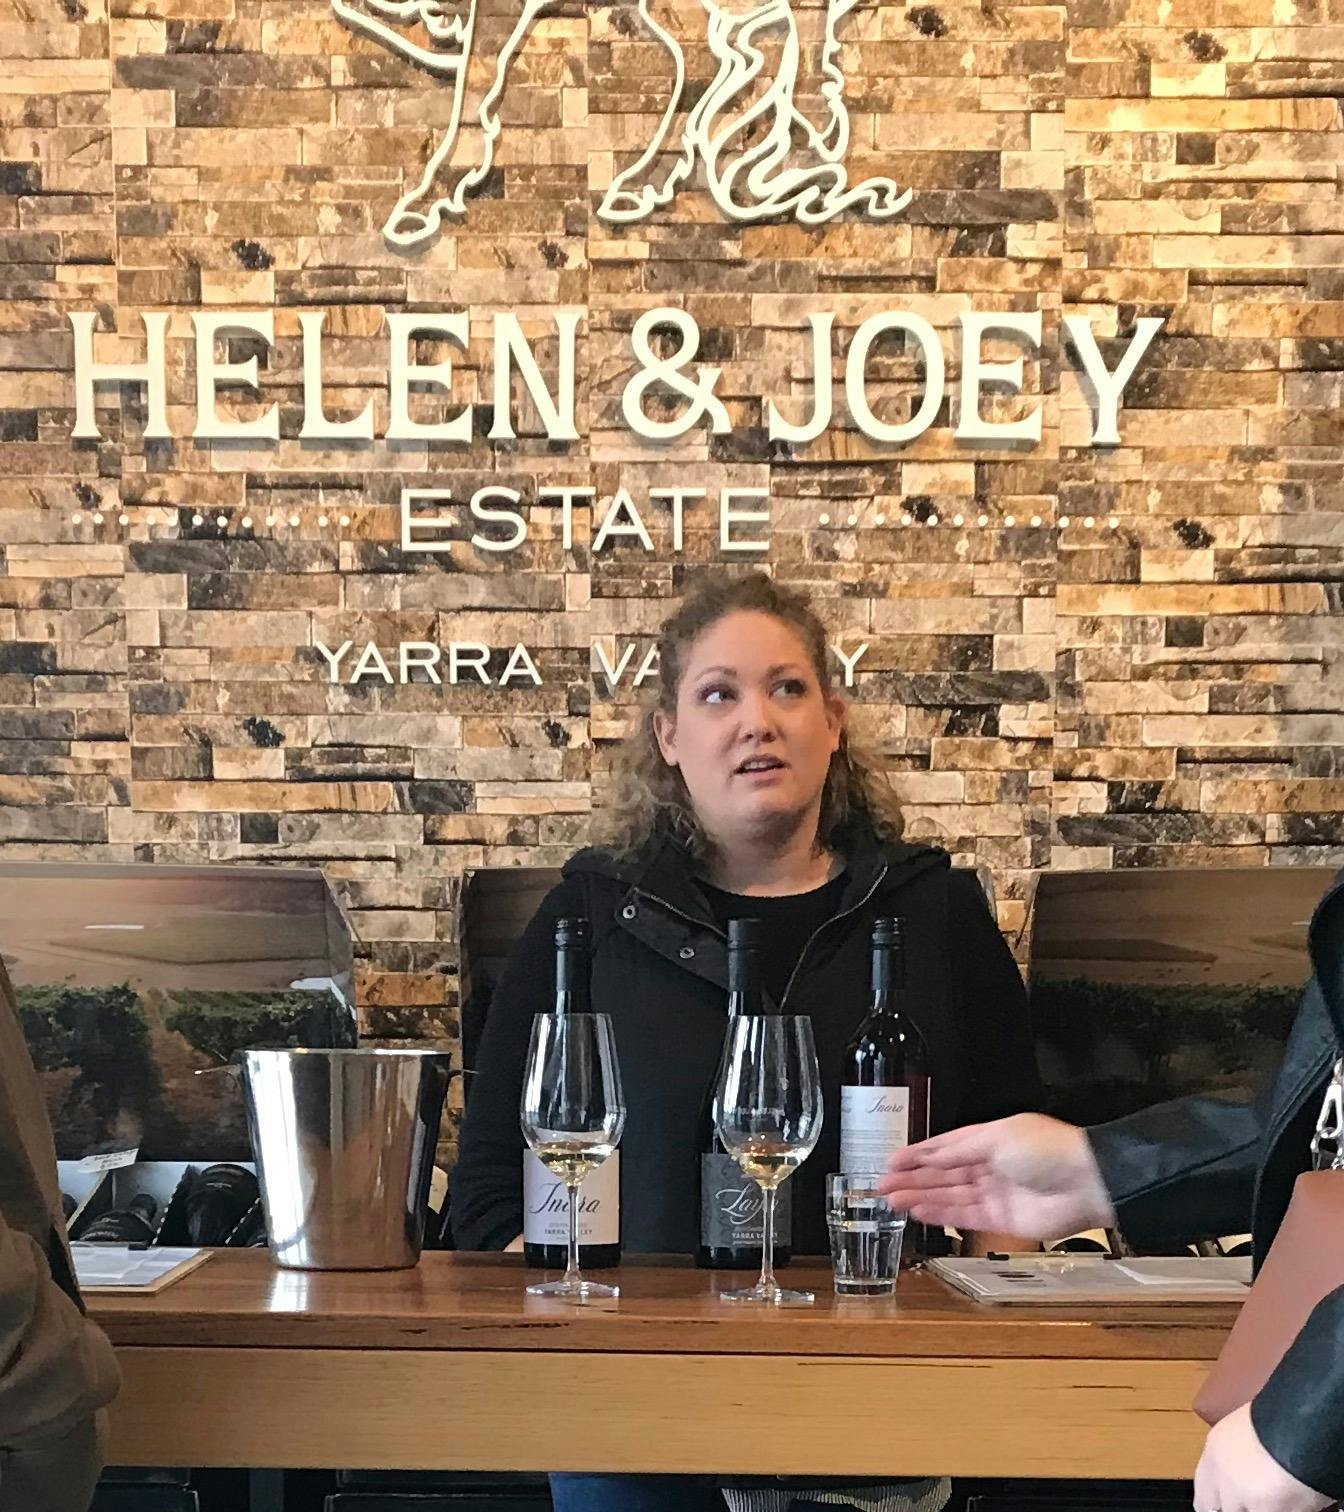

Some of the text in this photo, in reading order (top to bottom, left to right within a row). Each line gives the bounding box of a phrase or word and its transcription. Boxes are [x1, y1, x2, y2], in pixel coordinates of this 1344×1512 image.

[68, 307, 1166, 447] HELEN & JOEY
[400, 486, 771, 552] ESTATE
[311, 640, 544, 686] YARRA
